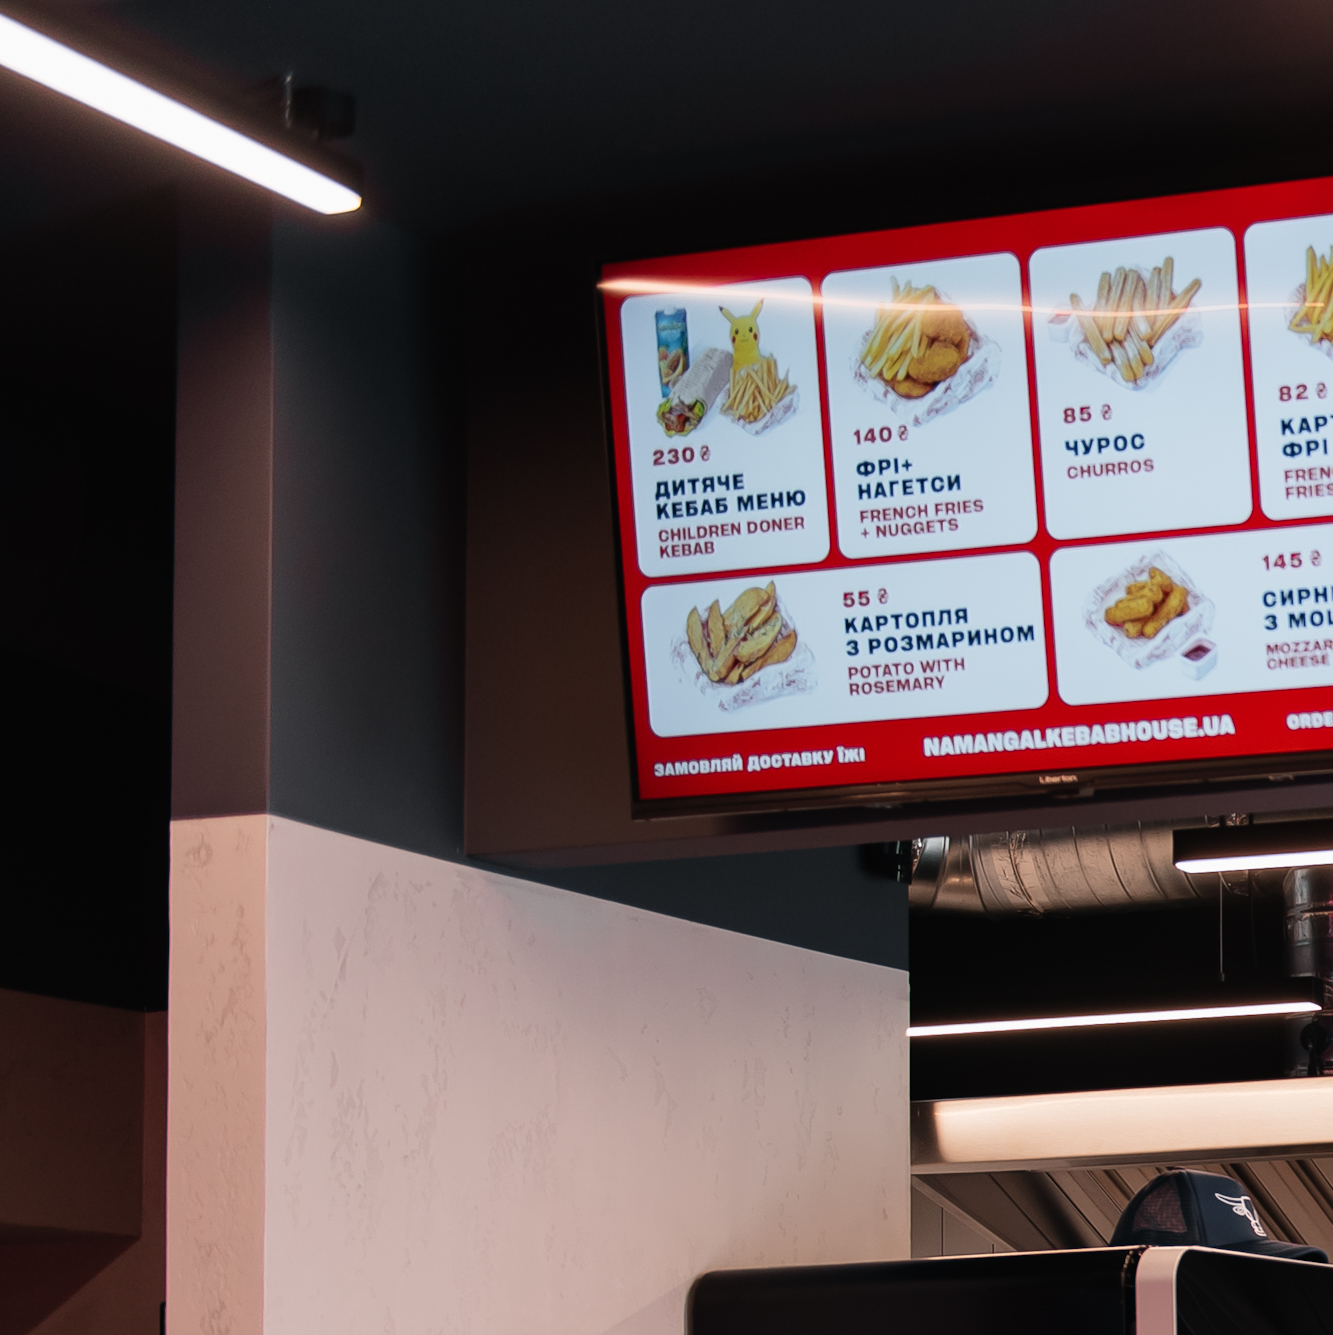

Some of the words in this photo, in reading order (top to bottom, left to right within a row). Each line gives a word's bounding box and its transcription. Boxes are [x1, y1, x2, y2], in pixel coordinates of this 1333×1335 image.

[1279, 384, 1308, 401] 82
[1064, 406, 1092, 423] 85
[854, 427, 892, 445] 140
[1065, 434, 1145, 456] ЧУРОС
[653, 448, 694, 466] 230
[1282, 439, 1327, 458] ФРІ
[856, 459, 912, 476] ФРІ+
[1067, 459, 1154, 479] CHURROS
[655, 474, 744, 500] ДИТЯЧЕ
[858, 475, 961, 500] НАГЕТСИ
[656, 496, 729, 519] КЕБАБ
[737, 491, 806, 512] МЕНЮ
[860, 505, 928, 523] FRENCH
[934, 500, 984, 516] FRIES
[658, 520, 742, 542] CHILDREN
[747, 517, 805, 534] DONER
[876, 518, 959, 538] NUGGETS
[660, 541, 715, 558] KEBAB
[1263, 552, 1302, 570] 145
[843, 590, 870, 608] 55
[845, 608, 968, 633] КАРТОПЛЯ
[1264, 615, 1277, 630] З
[847, 639, 859, 656] З
[869, 625, 1034, 654] РОЗМАРИНОМ
[848, 661, 914, 680] POTATO
[920, 658, 965, 674] WITH
[1268, 652, 1330, 670] CHEESE
[850, 676, 945, 695] ROSEMARY
[923, 713, 1236, 757] NAMANGALKEBABHOUSE.UA
[654, 753, 743, 777] ЗАМОВЛЯЙ
[747, 750, 833, 772] ДОСТАВКУ
[837, 746, 865, 763] ЇЖІ
